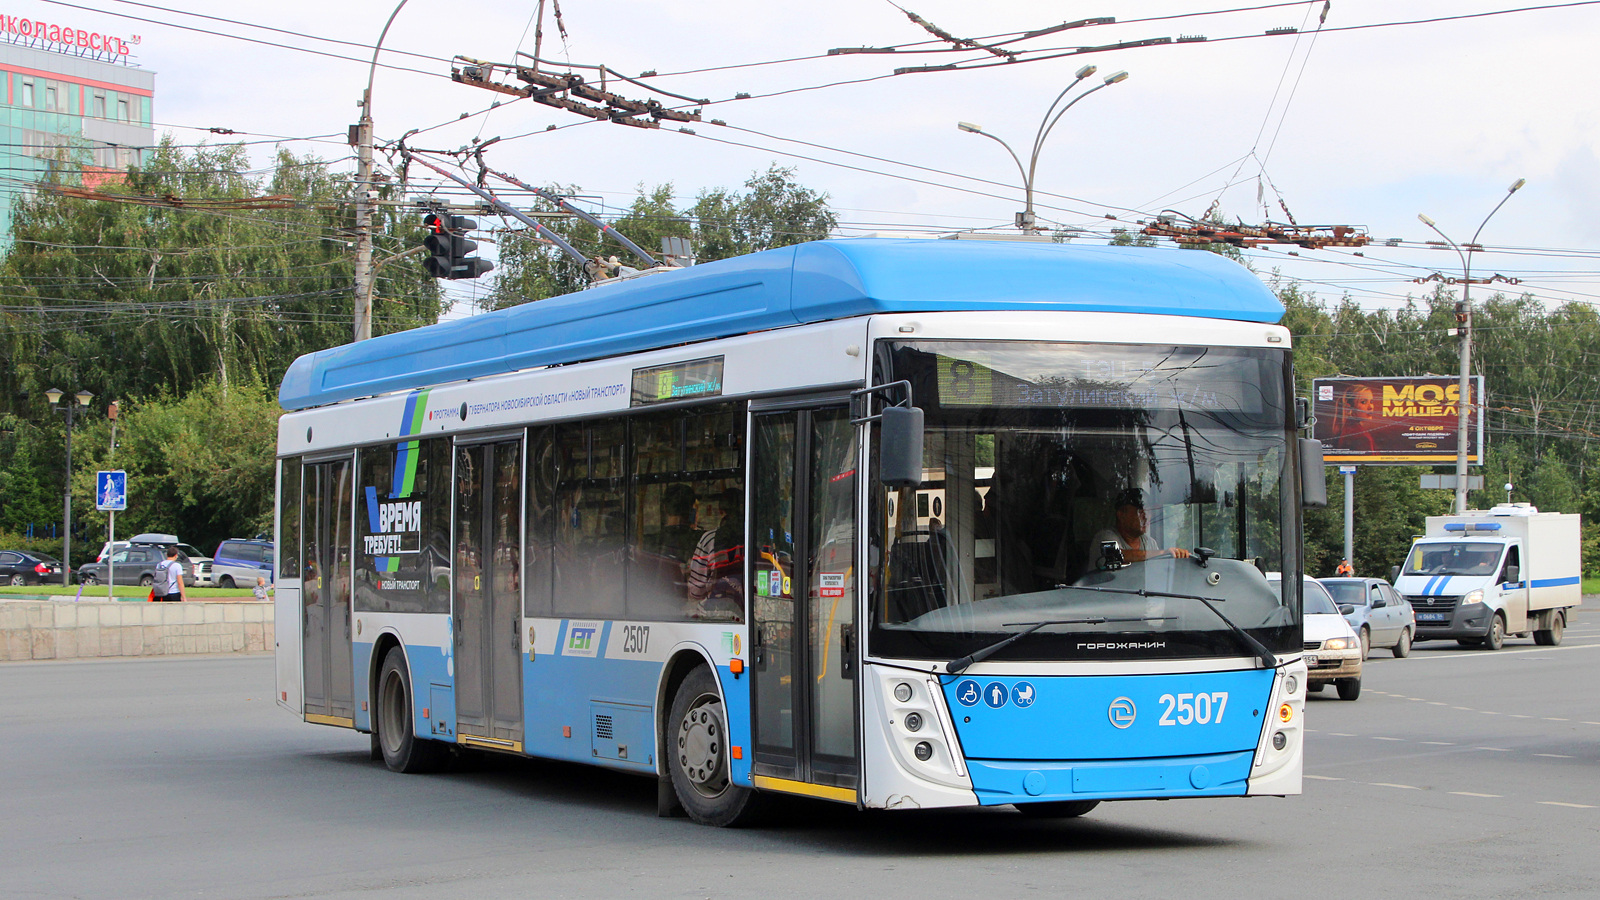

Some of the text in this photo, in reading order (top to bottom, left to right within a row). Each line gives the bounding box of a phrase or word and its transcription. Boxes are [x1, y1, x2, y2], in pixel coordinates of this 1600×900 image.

[662, 374, 669, 395] 8
[950, 358, 977, 400] 8
[1382, 384, 1472, 406] МОЯ
[433, 407, 460, 420] ПРОГРАММА
[468, 401, 500, 415] ГУБЕРНАТОРА
[500, 393, 543, 411] НОВОСИБИРСКОЙ
[543, 392, 568, 405] ОБЛАСТИ
[1382, 406, 1471, 417] МИШЕЛ
[380, 501, 421, 532] ВРЕМЯ
[364, 535, 401, 555] ТРЕБУЕТ!
[381, 578, 420, 590] НОВЫЙ ТРАНСПОРТ
[569, 628, 596, 649] ГЭТ
[623, 625, 650, 653] 2507
[1077, 641, 1166, 650] ГОРОЖАНИН
[1158, 691, 1229, 726] 2507
